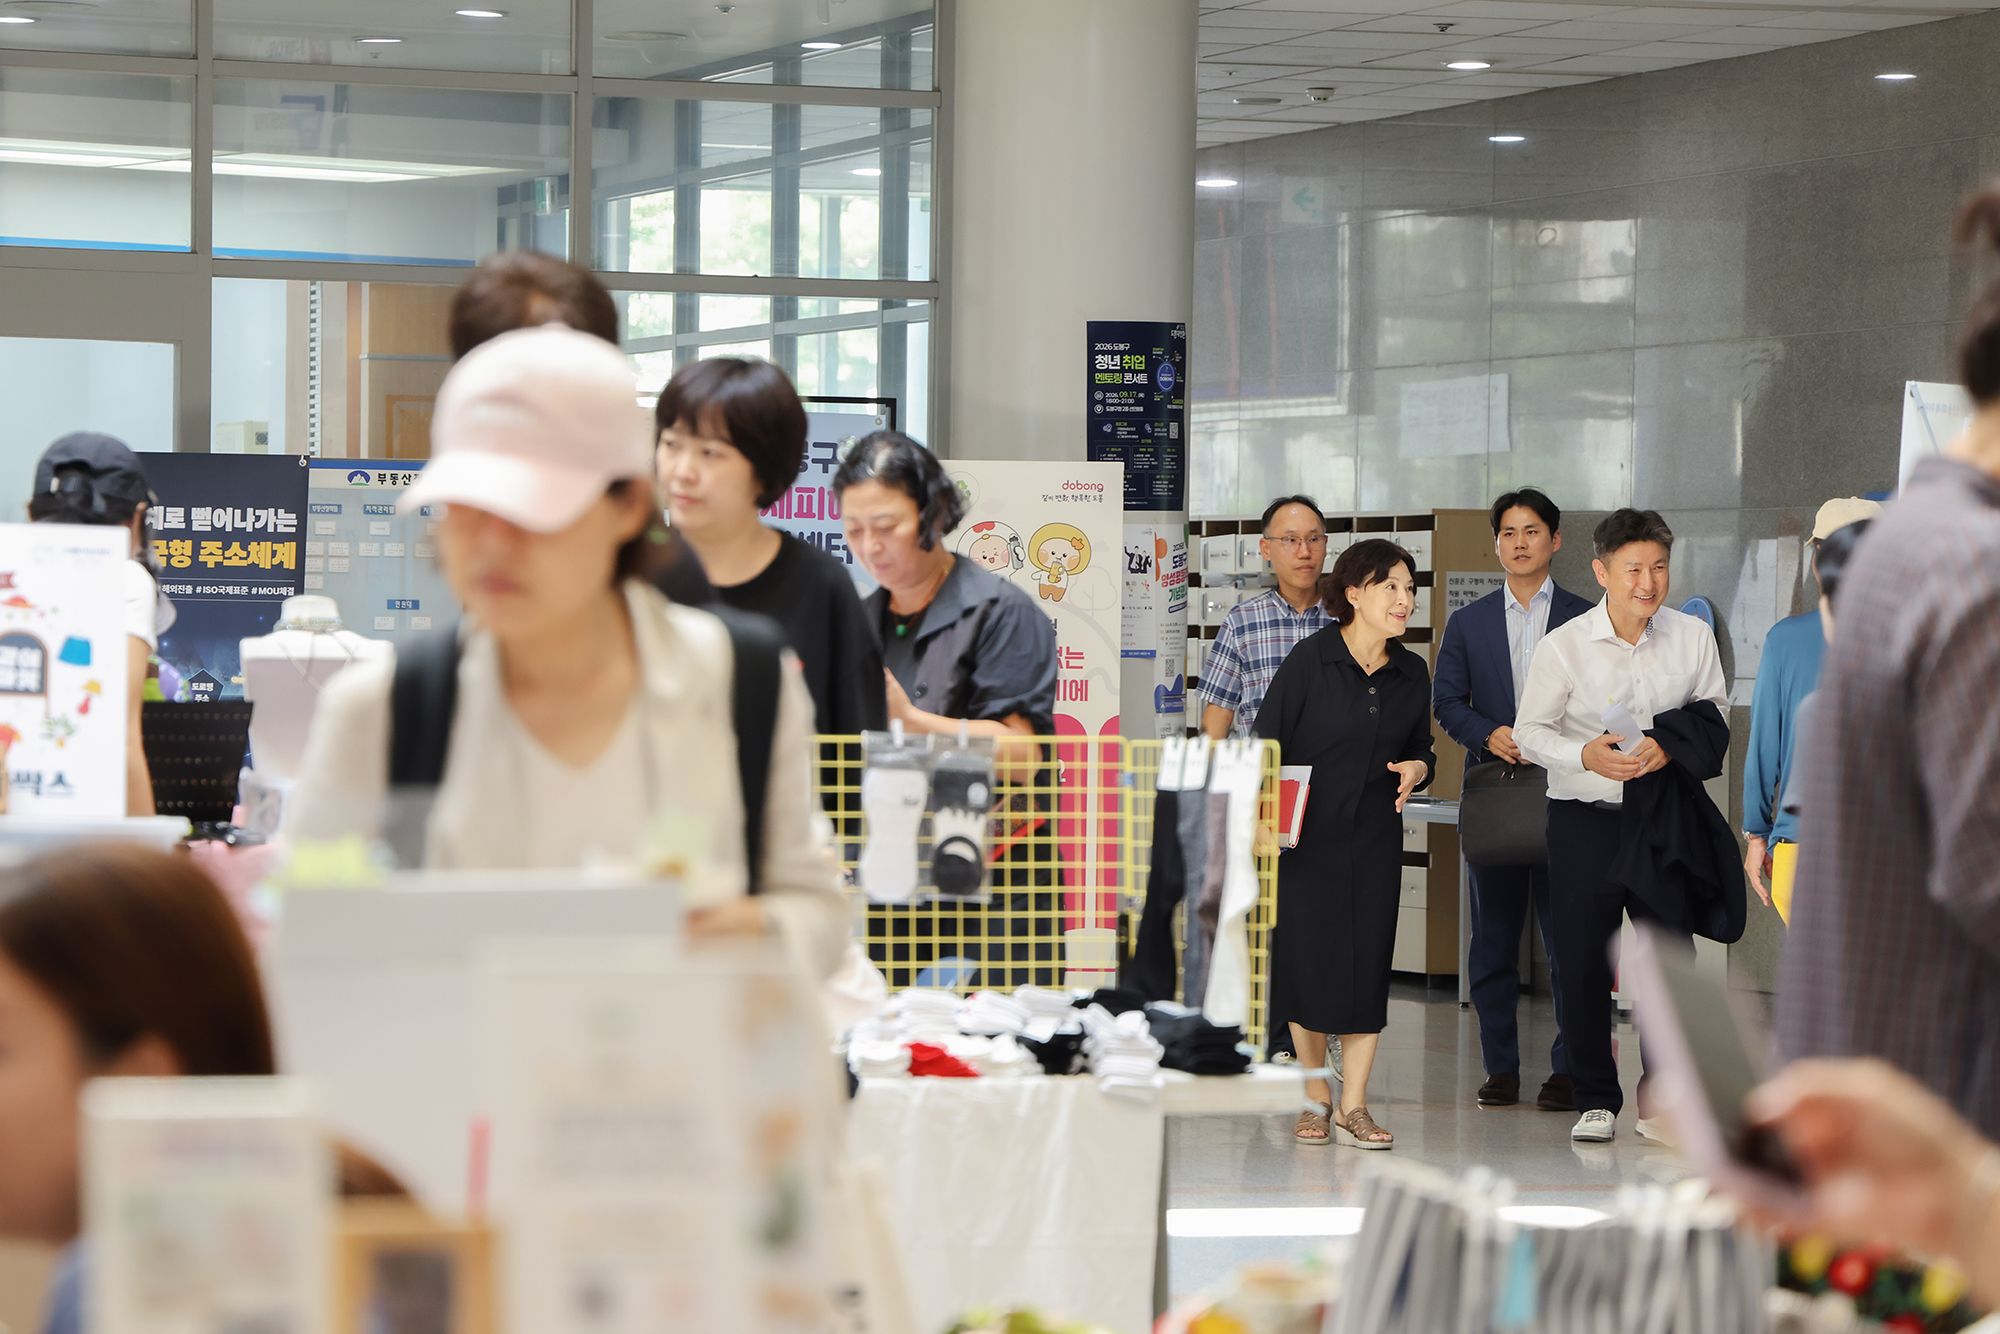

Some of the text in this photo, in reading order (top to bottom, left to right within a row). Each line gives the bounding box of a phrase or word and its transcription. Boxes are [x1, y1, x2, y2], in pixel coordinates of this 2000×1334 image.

[1095, 354, 1145, 370] 청년 취업
[1095, 373, 1148, 384] 멘토링 콘서트
[1062, 480, 1104, 492] dobong
[191, 506, 298, 533] 뻗어나가는
[198, 541, 297, 570] 주소체계
[158, 584, 194, 595] 해외진출
[191, 682, 214, 692] 도로명
[194, 693, 210, 703] 주소
